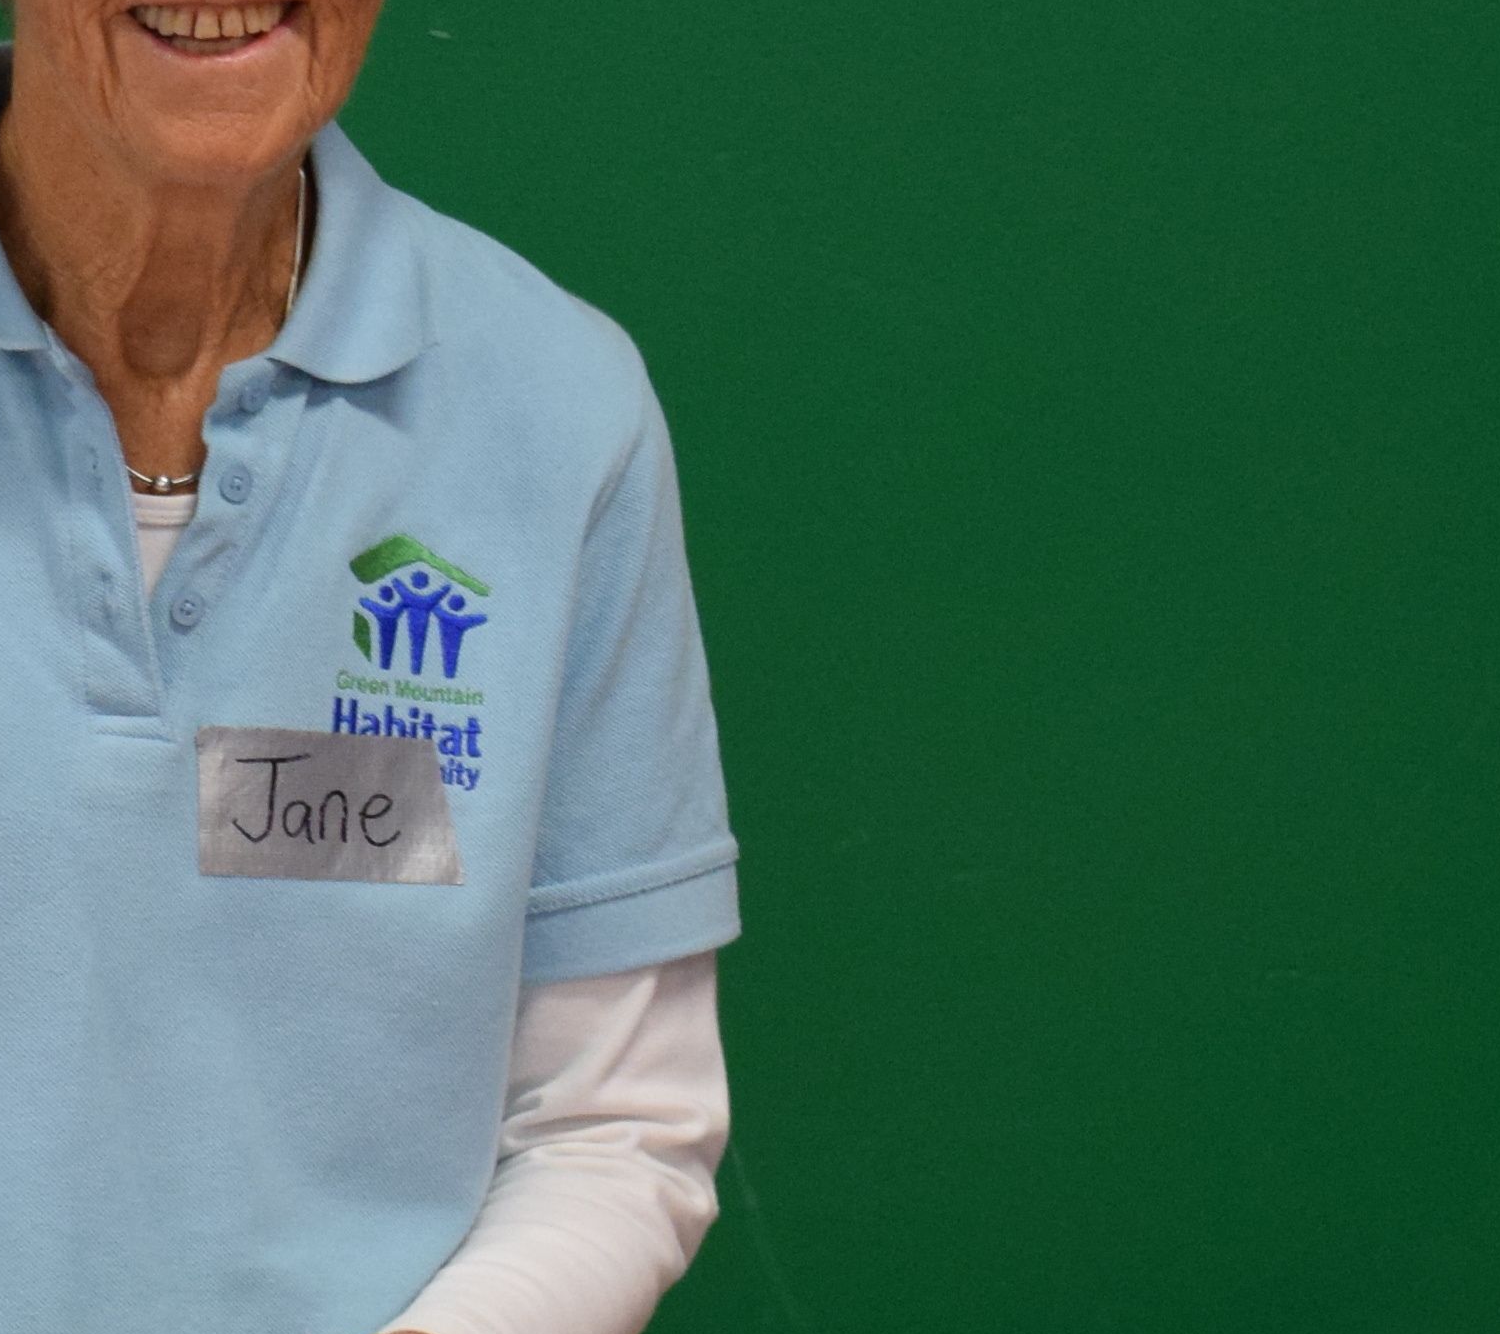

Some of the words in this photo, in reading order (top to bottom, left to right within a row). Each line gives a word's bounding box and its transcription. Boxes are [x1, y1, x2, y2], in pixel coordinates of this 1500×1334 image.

[336, 668, 390, 695] Green
[394, 679, 485, 706] Mountain
[332, 696, 482, 758] Habitat
[232, 753, 401, 848] Jane
